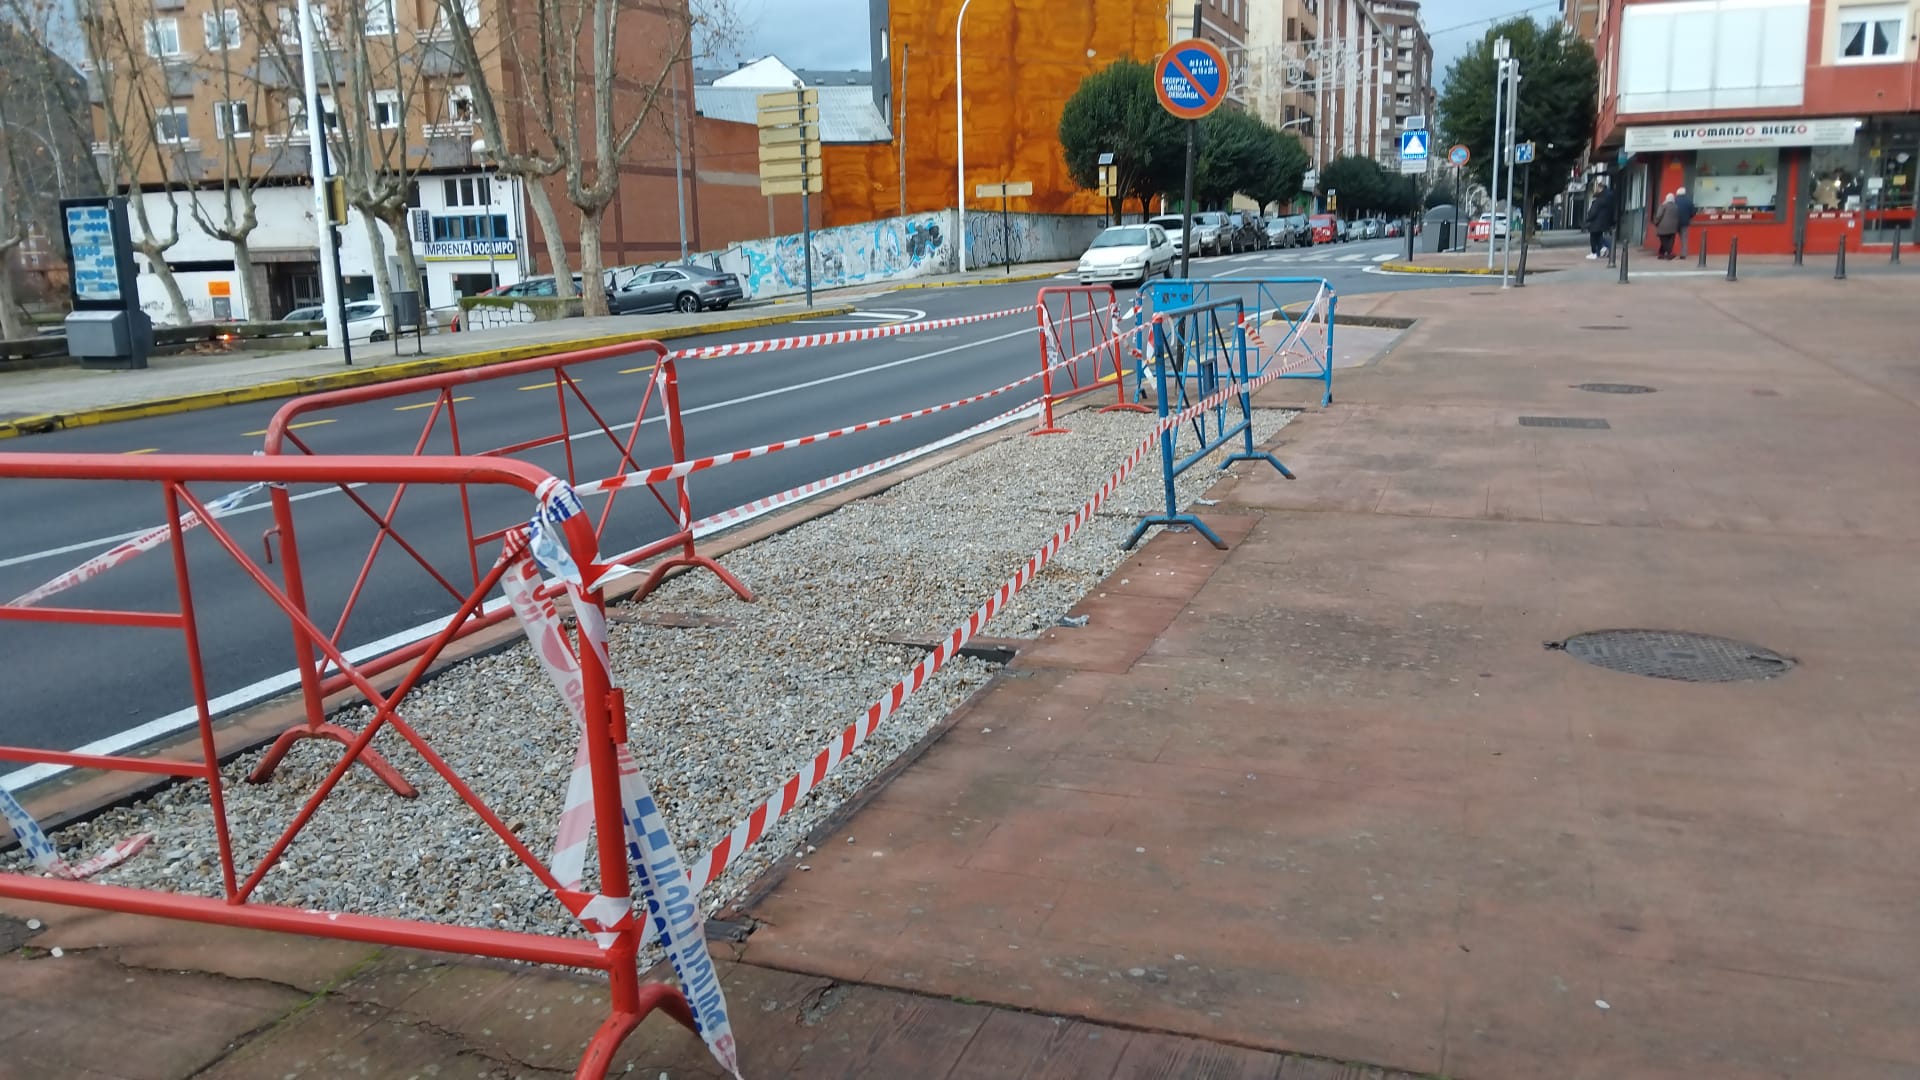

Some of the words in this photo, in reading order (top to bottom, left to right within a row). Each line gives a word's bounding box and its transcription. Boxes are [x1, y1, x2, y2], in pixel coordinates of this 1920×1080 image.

[1161, 77, 1187, 85] EXCEPTO
[1168, 91, 1199, 99] DESCARGA
[1673, 126, 1755, 138] AUTOMANDO
[1761, 124, 1807, 136] BIERZO
[424, 241, 471, 255] IMPRENTA
